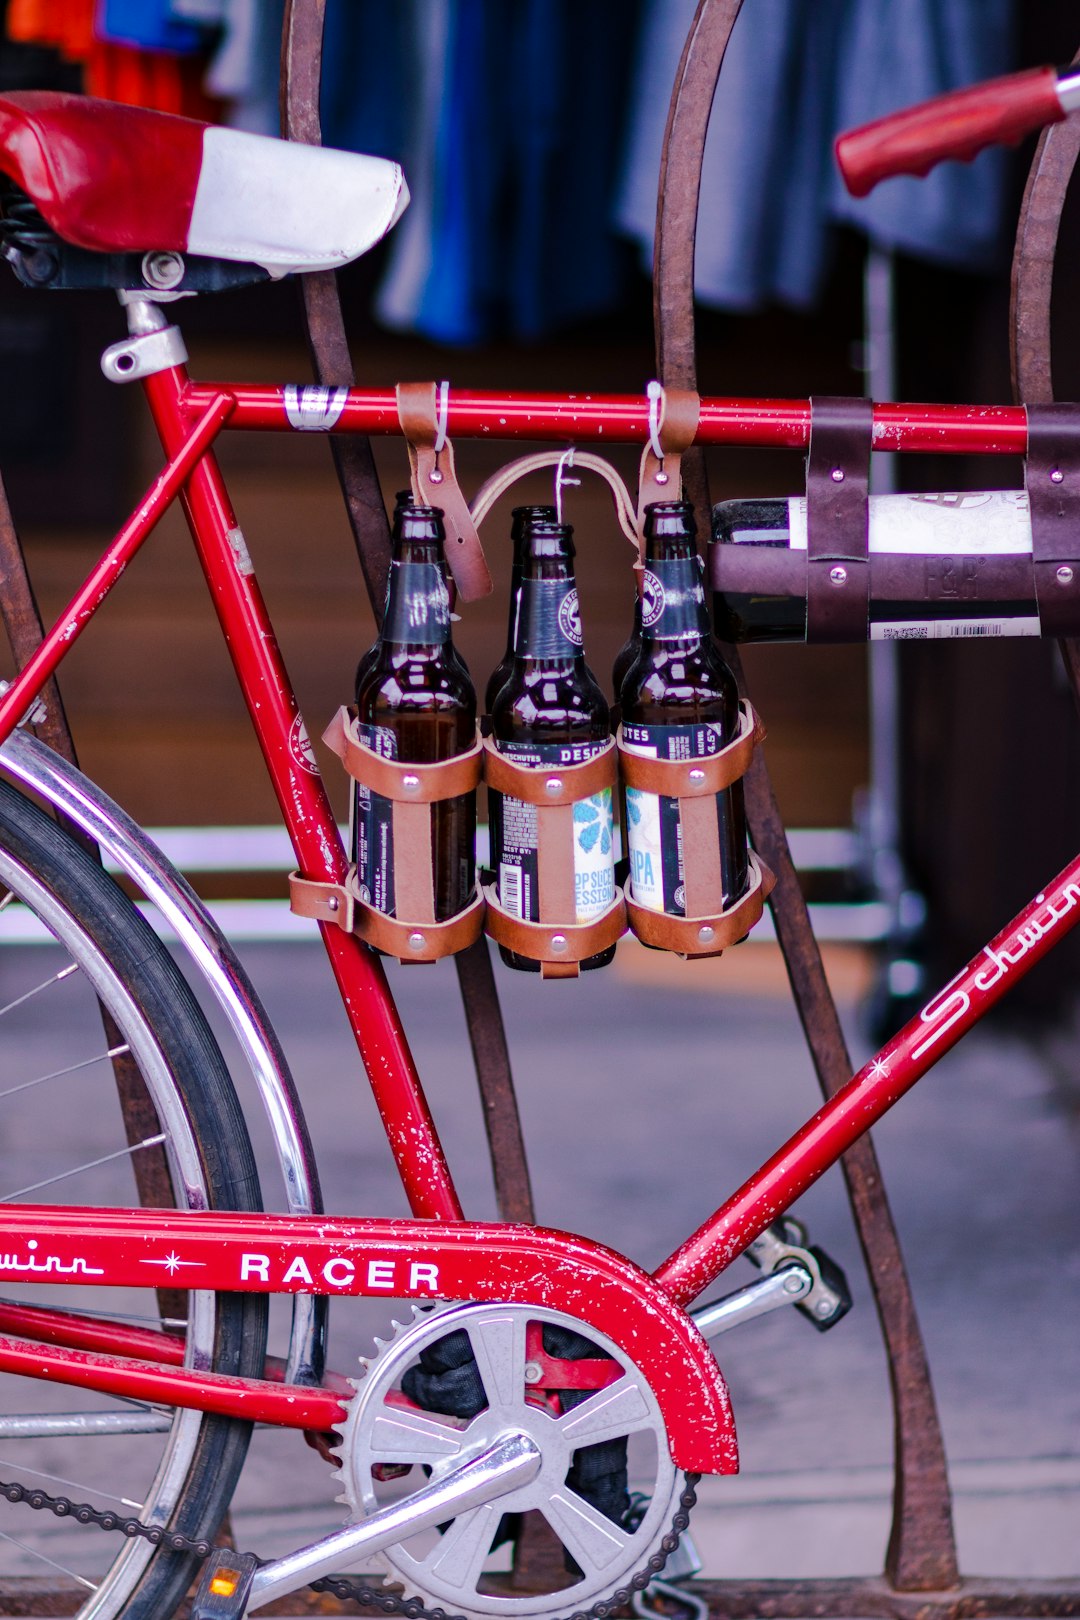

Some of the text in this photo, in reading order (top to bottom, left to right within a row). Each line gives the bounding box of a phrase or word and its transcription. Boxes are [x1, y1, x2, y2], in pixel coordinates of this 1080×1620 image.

[503, 846, 532, 855] BEST BY:
[240, 1253, 439, 1291] RACER
